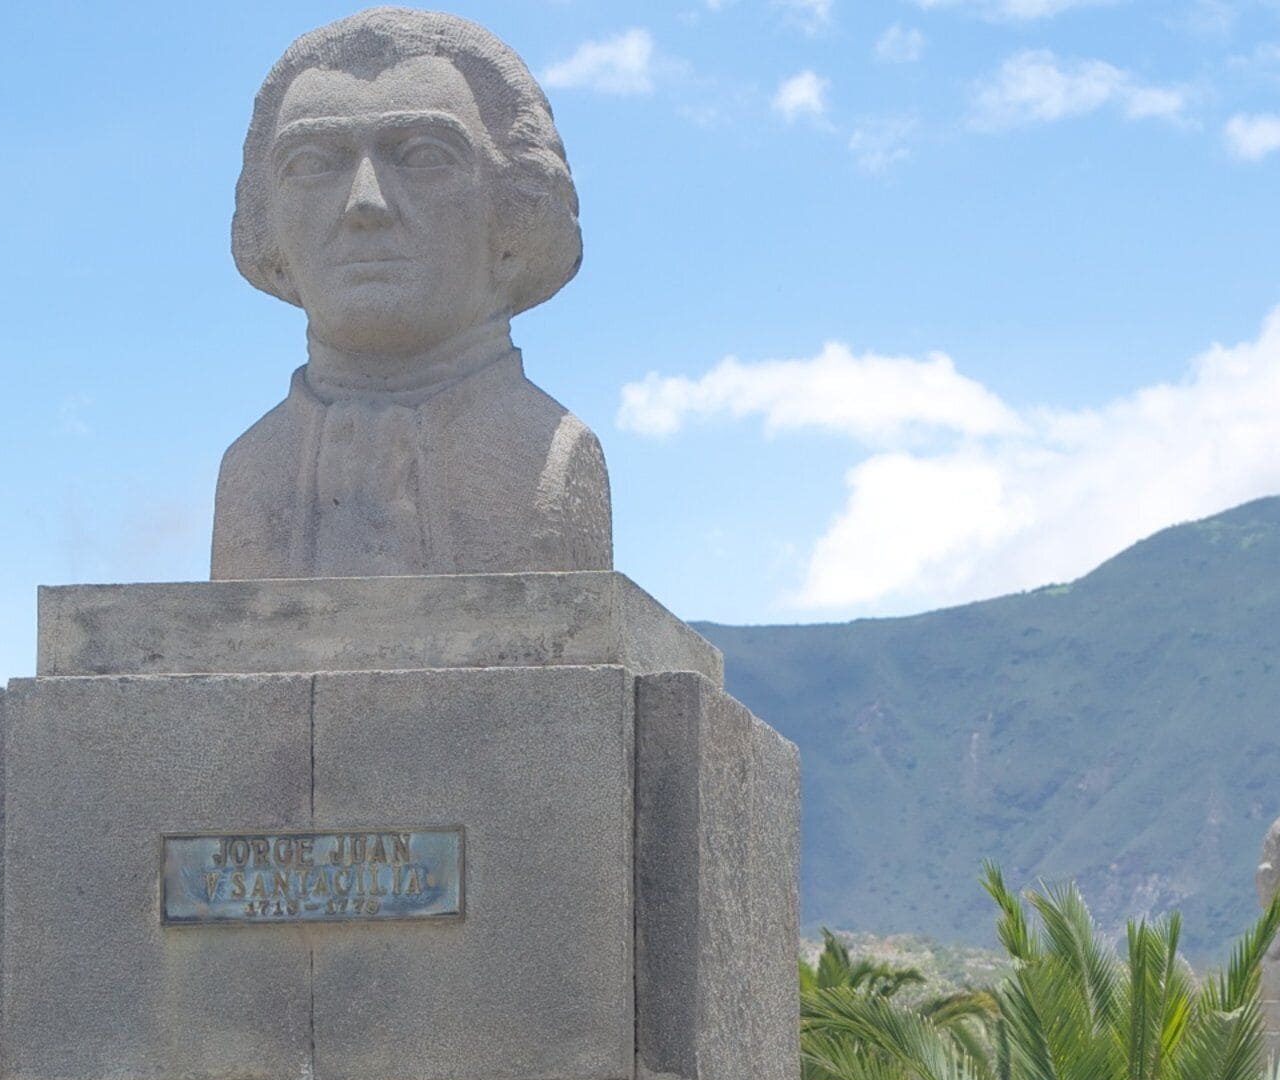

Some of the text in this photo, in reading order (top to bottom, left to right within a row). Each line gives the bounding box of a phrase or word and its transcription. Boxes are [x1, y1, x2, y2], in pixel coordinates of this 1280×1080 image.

[212, 832, 411, 867] JORGE JUAN
[231, 864, 421, 898] SANTACILIA
